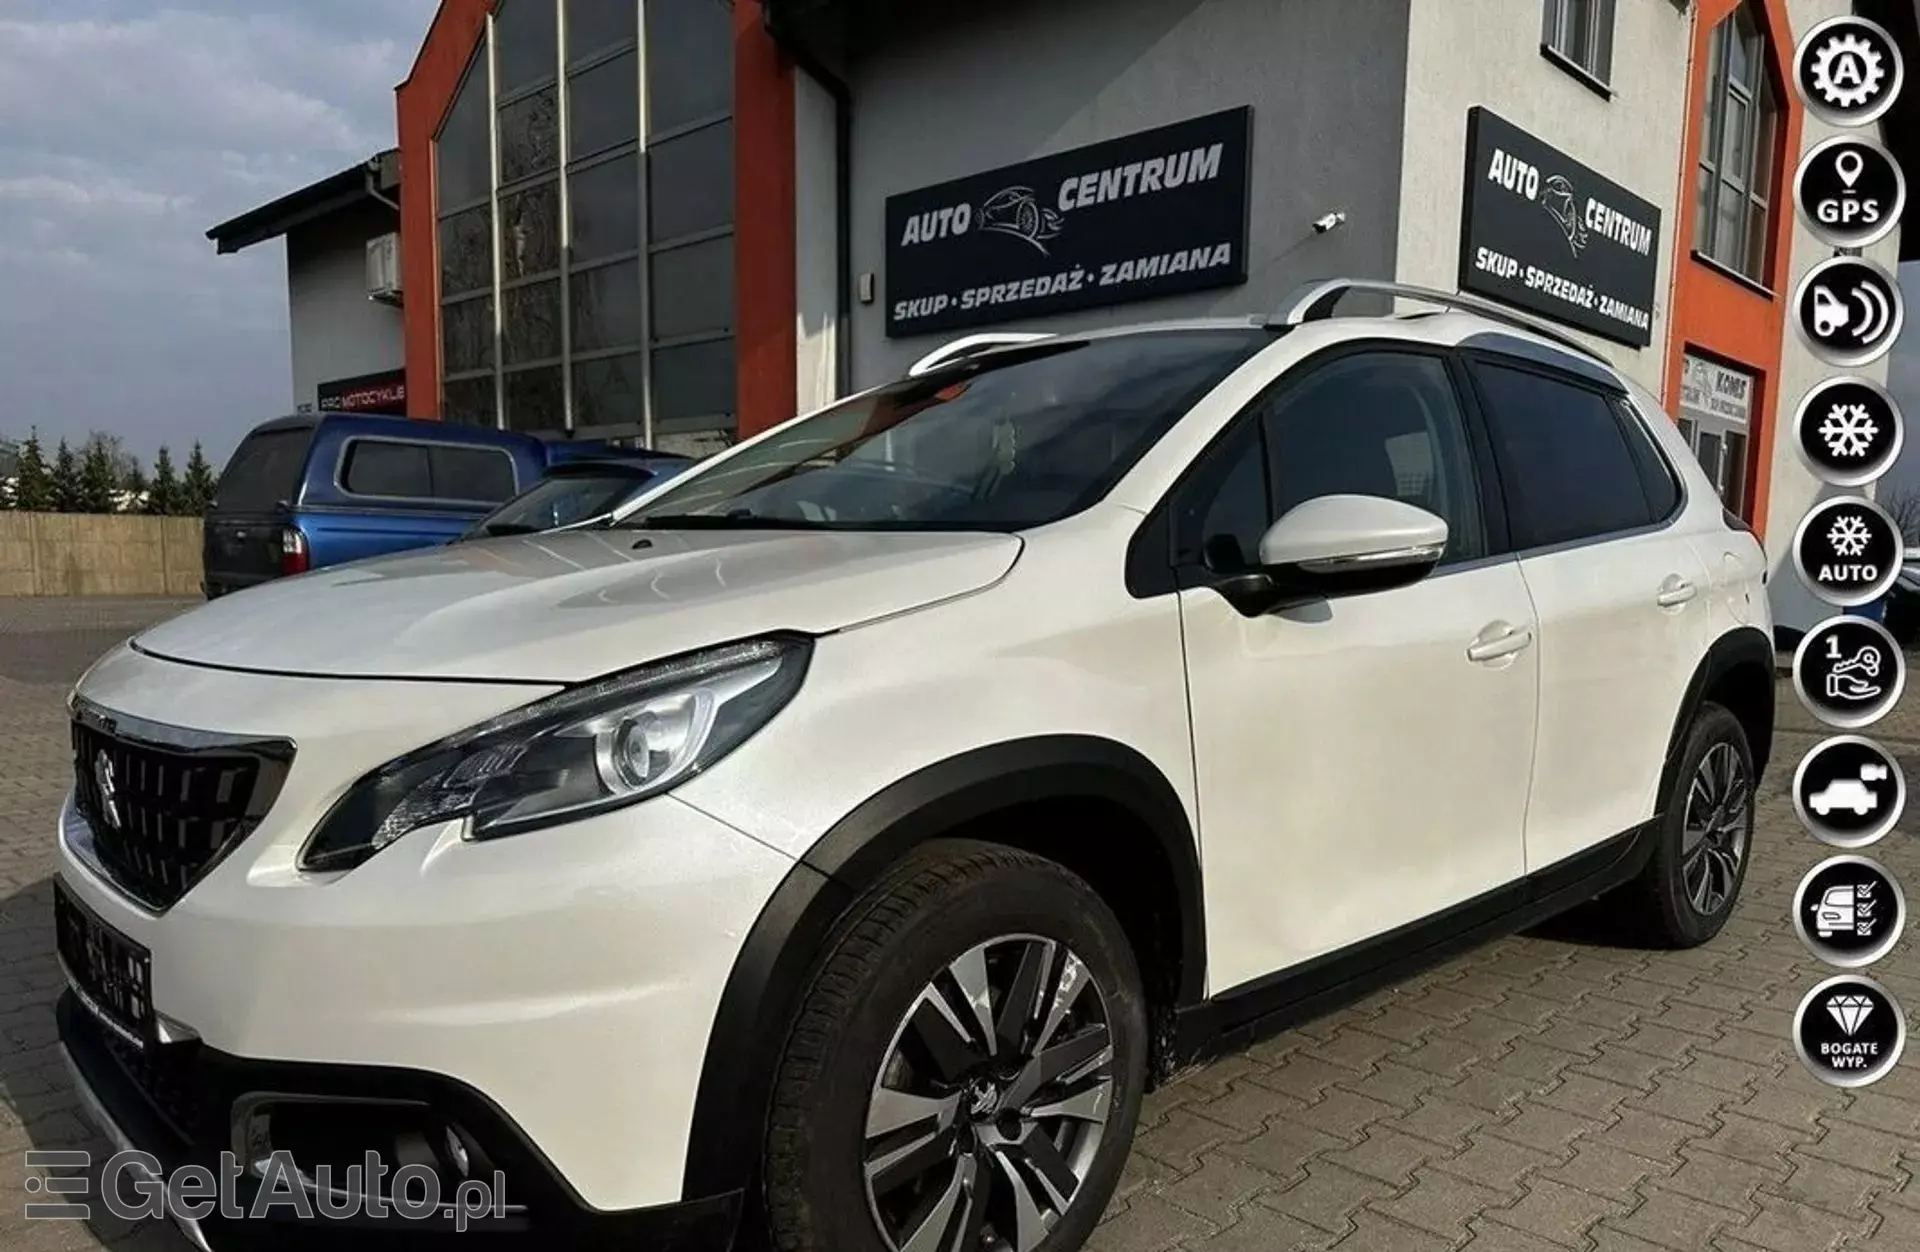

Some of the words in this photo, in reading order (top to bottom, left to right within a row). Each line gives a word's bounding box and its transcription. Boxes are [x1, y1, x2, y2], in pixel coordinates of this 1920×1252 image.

[901, 203, 972, 247] AUTO
[1057, 142, 1224, 211] CENTRUM
[1487, 148, 1540, 201] AUTO
[1584, 197, 1652, 256] CENTRUM
[893, 293, 949, 321] SKUP
[960, 263, 1086, 311] SPRZEDAŻ
[1099, 242, 1231, 285] ZAMIANA
[1475, 246, 1518, 280] SKUP
[1524, 264, 1594, 309] SPRZEDAŻ
[1598, 294, 1650, 331] ZAMIANA
